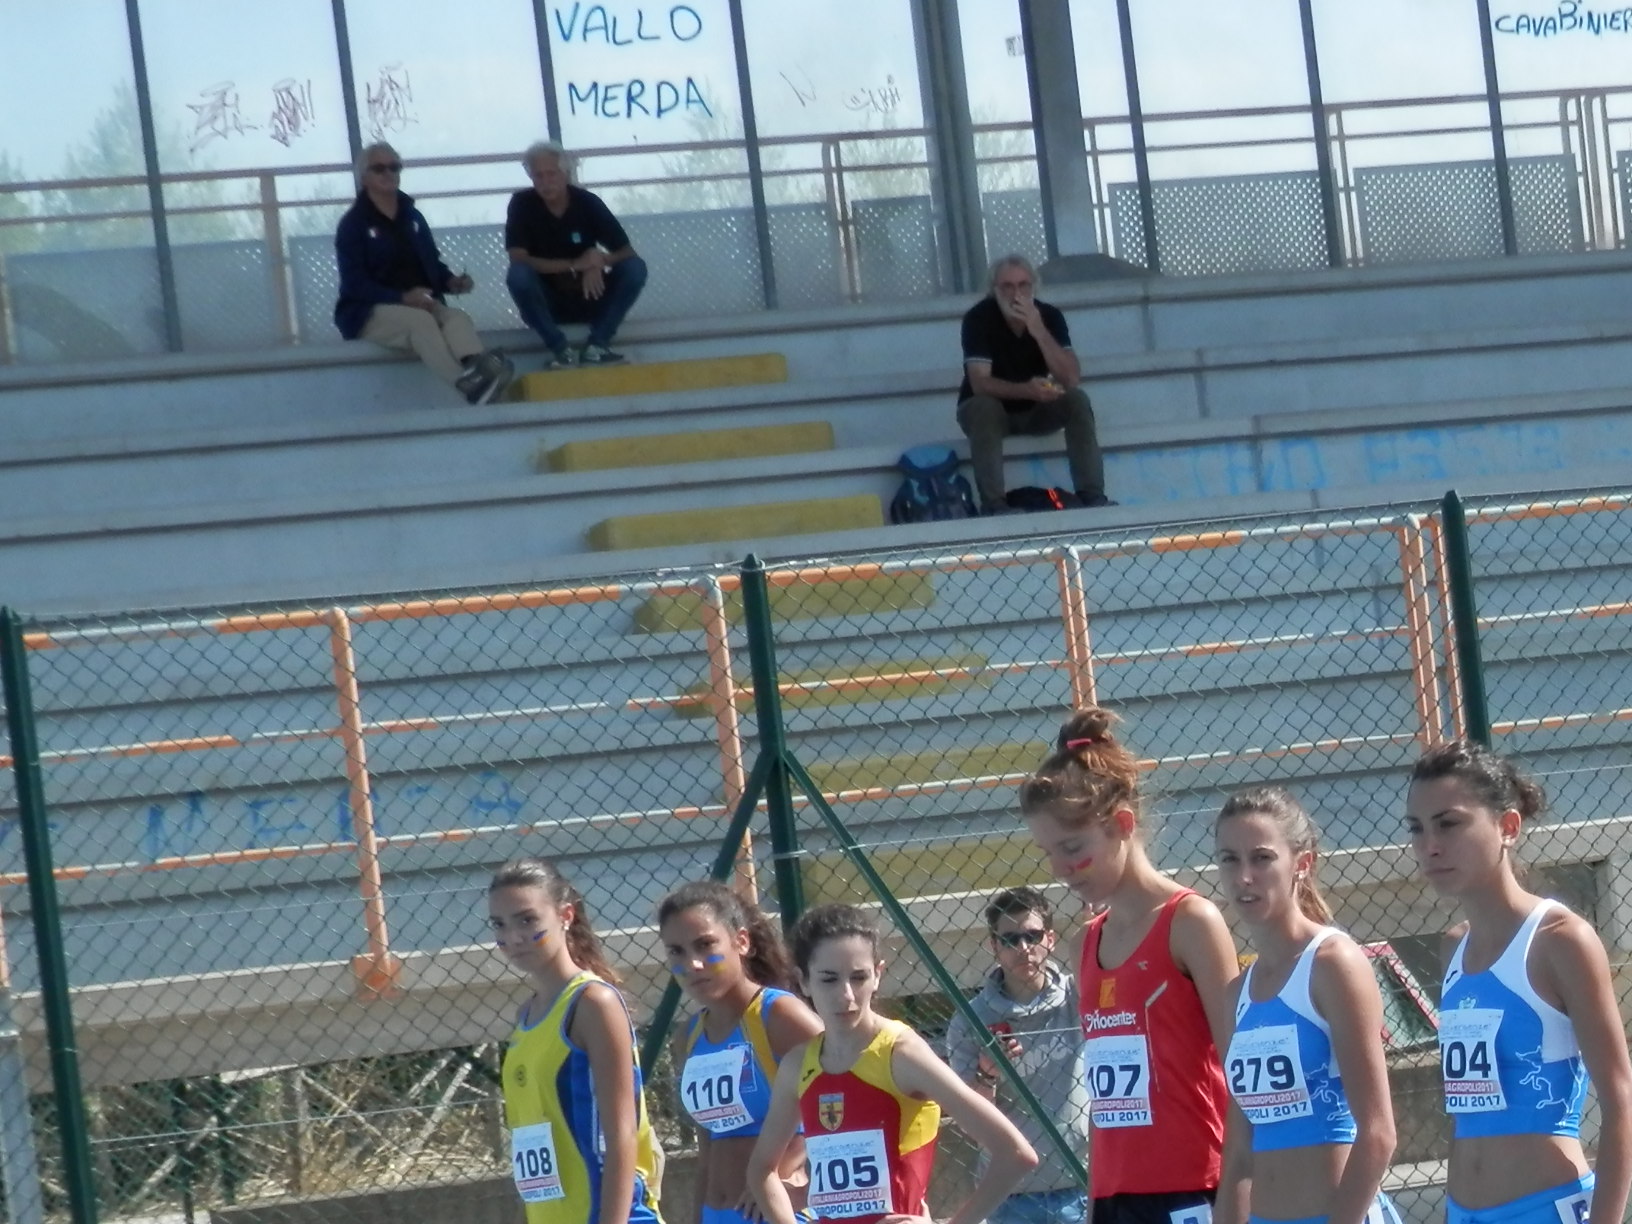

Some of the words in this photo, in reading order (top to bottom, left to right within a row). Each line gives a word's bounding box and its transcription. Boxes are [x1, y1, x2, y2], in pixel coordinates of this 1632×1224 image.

[555, 2, 702, 45] VALLO
[567, 76, 713, 120] MERDA
[1230, 1055, 1297, 1095] 279
[1440, 1040, 1492, 1080] 04
[685, 1074, 734, 1111] 110
[1087, 1064, 1141, 1099] 107
[1119, 1111, 1148, 1122] 2017
[1273, 1101, 1308, 1118] 2017
[1471, 1094, 1500, 1109] 2017
[721, 1114, 747, 1128] 2017
[515, 1146, 554, 1179] 108
[815, 1155, 880, 1193] 105
[856, 1200, 887, 1212] 2017
